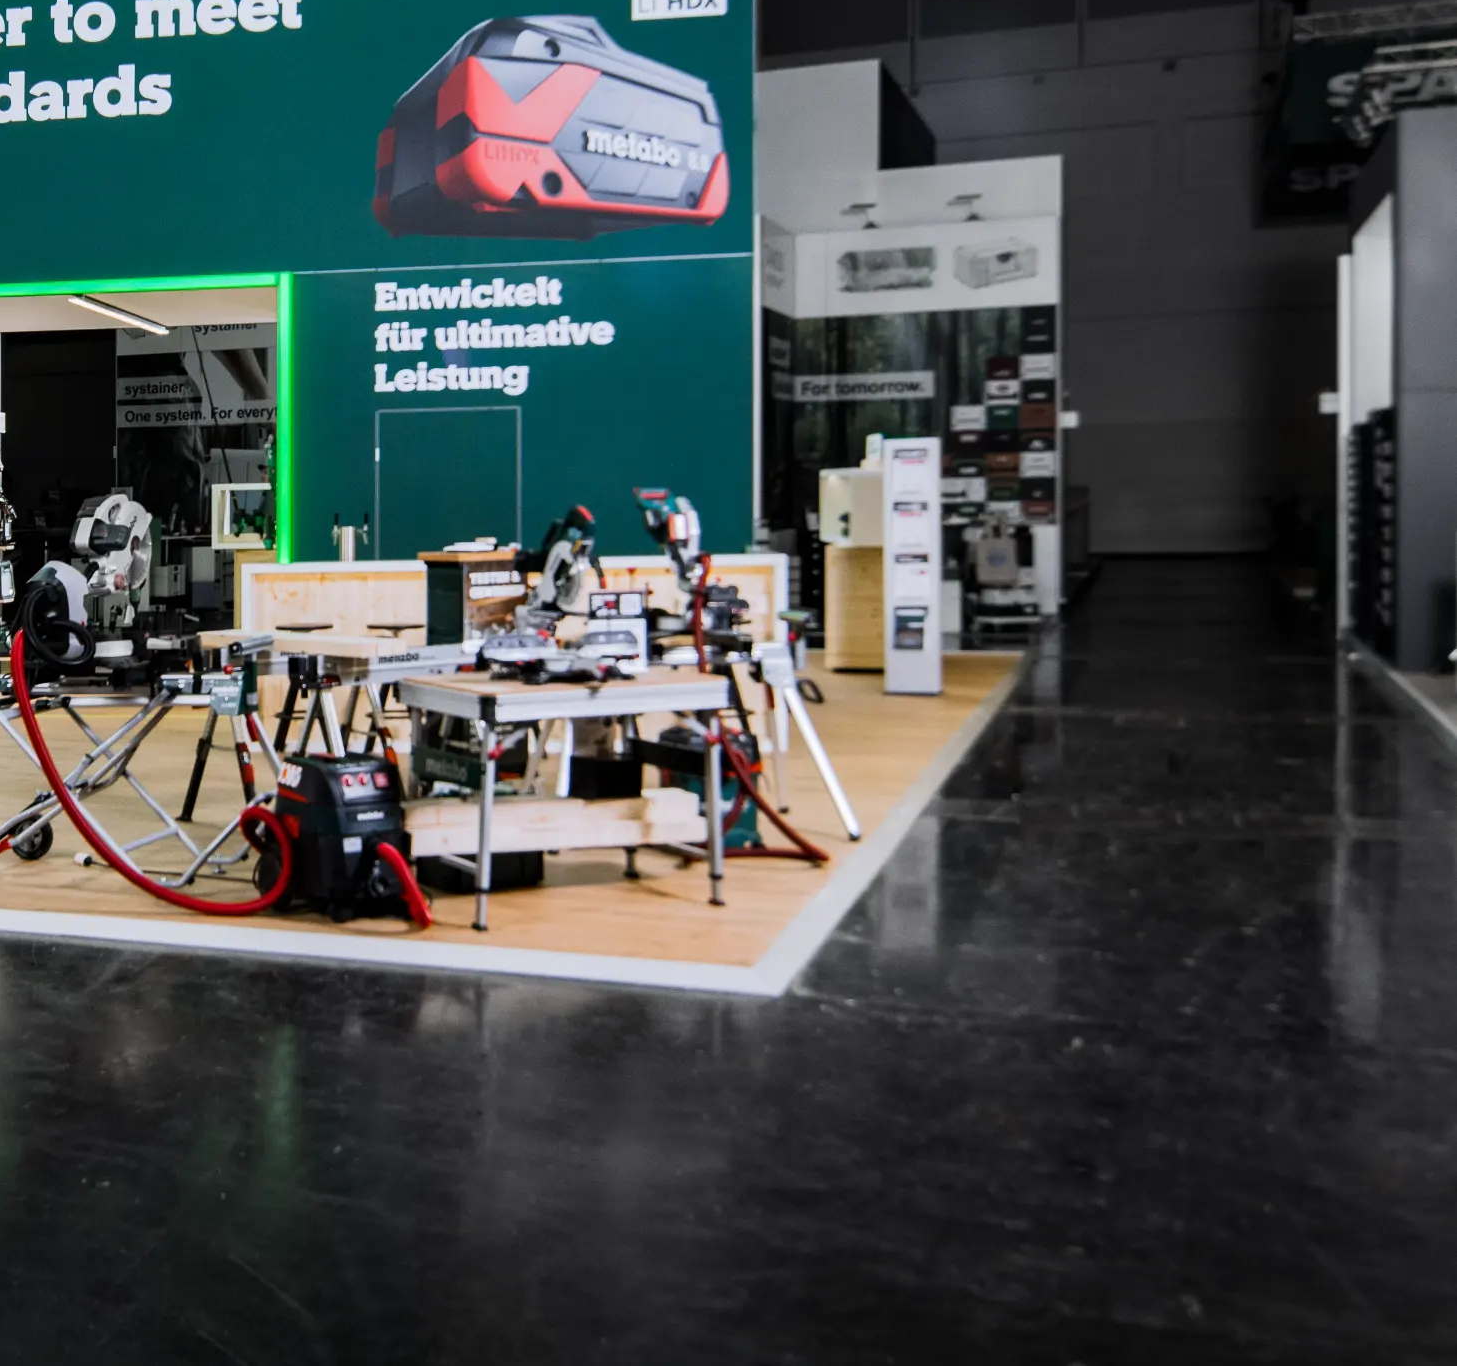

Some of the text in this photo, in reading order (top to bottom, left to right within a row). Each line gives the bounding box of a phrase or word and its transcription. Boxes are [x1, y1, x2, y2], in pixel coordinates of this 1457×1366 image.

[585, 128, 681, 168] metabo
[374, 276, 563, 312] Entwickelt
[374, 316, 615, 352] für ultimative
[124, 382, 184, 400] systainer
[374, 362, 530, 396] Leistung
[800, 380, 831, 397] For
[835, 378, 927, 396] tomorrow.
[124, 409, 151, 423] One
[155, 408, 207, 424] system.
[211, 406, 233, 420] For
